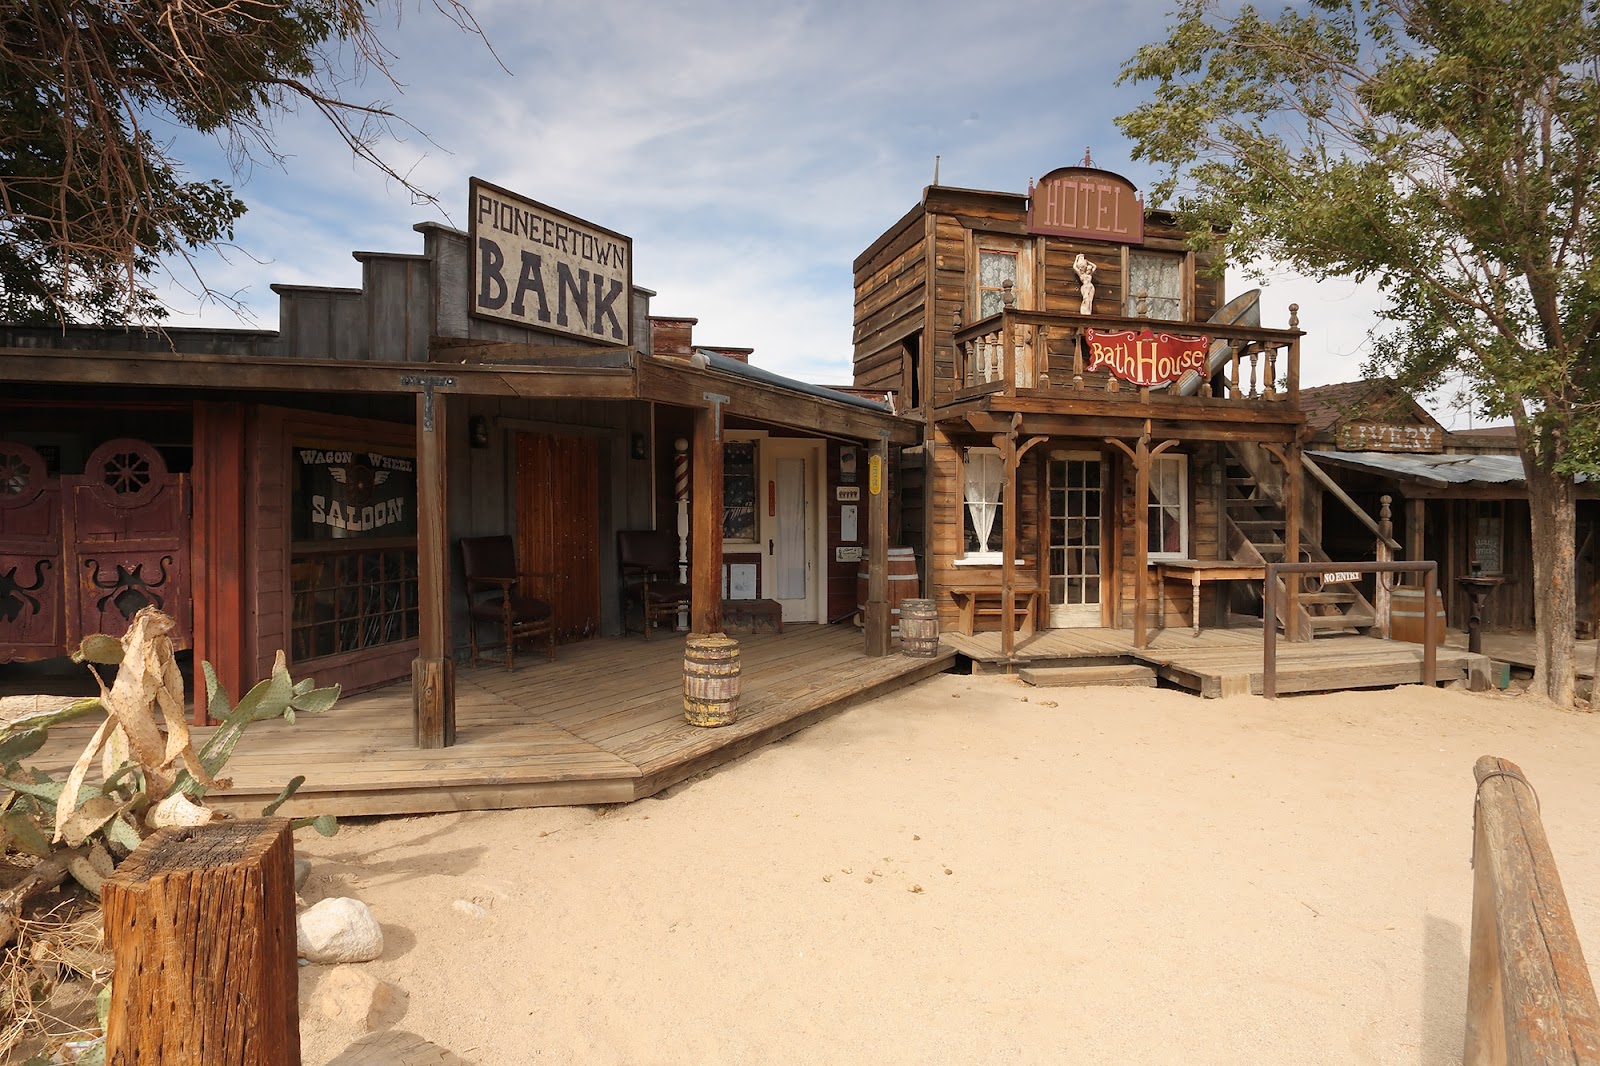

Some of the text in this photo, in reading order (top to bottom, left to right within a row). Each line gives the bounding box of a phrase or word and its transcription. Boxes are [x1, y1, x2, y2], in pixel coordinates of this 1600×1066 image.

[1044, 180, 1127, 233] HOTEL
[478, 195, 625, 269] PIONEERTOWN
[478, 237, 623, 340] BANK
[300, 450, 412, 472] WAGON WHEEL
[312, 495, 403, 531] SALOON
[1324, 572, 1359, 582] NO ENTRY
